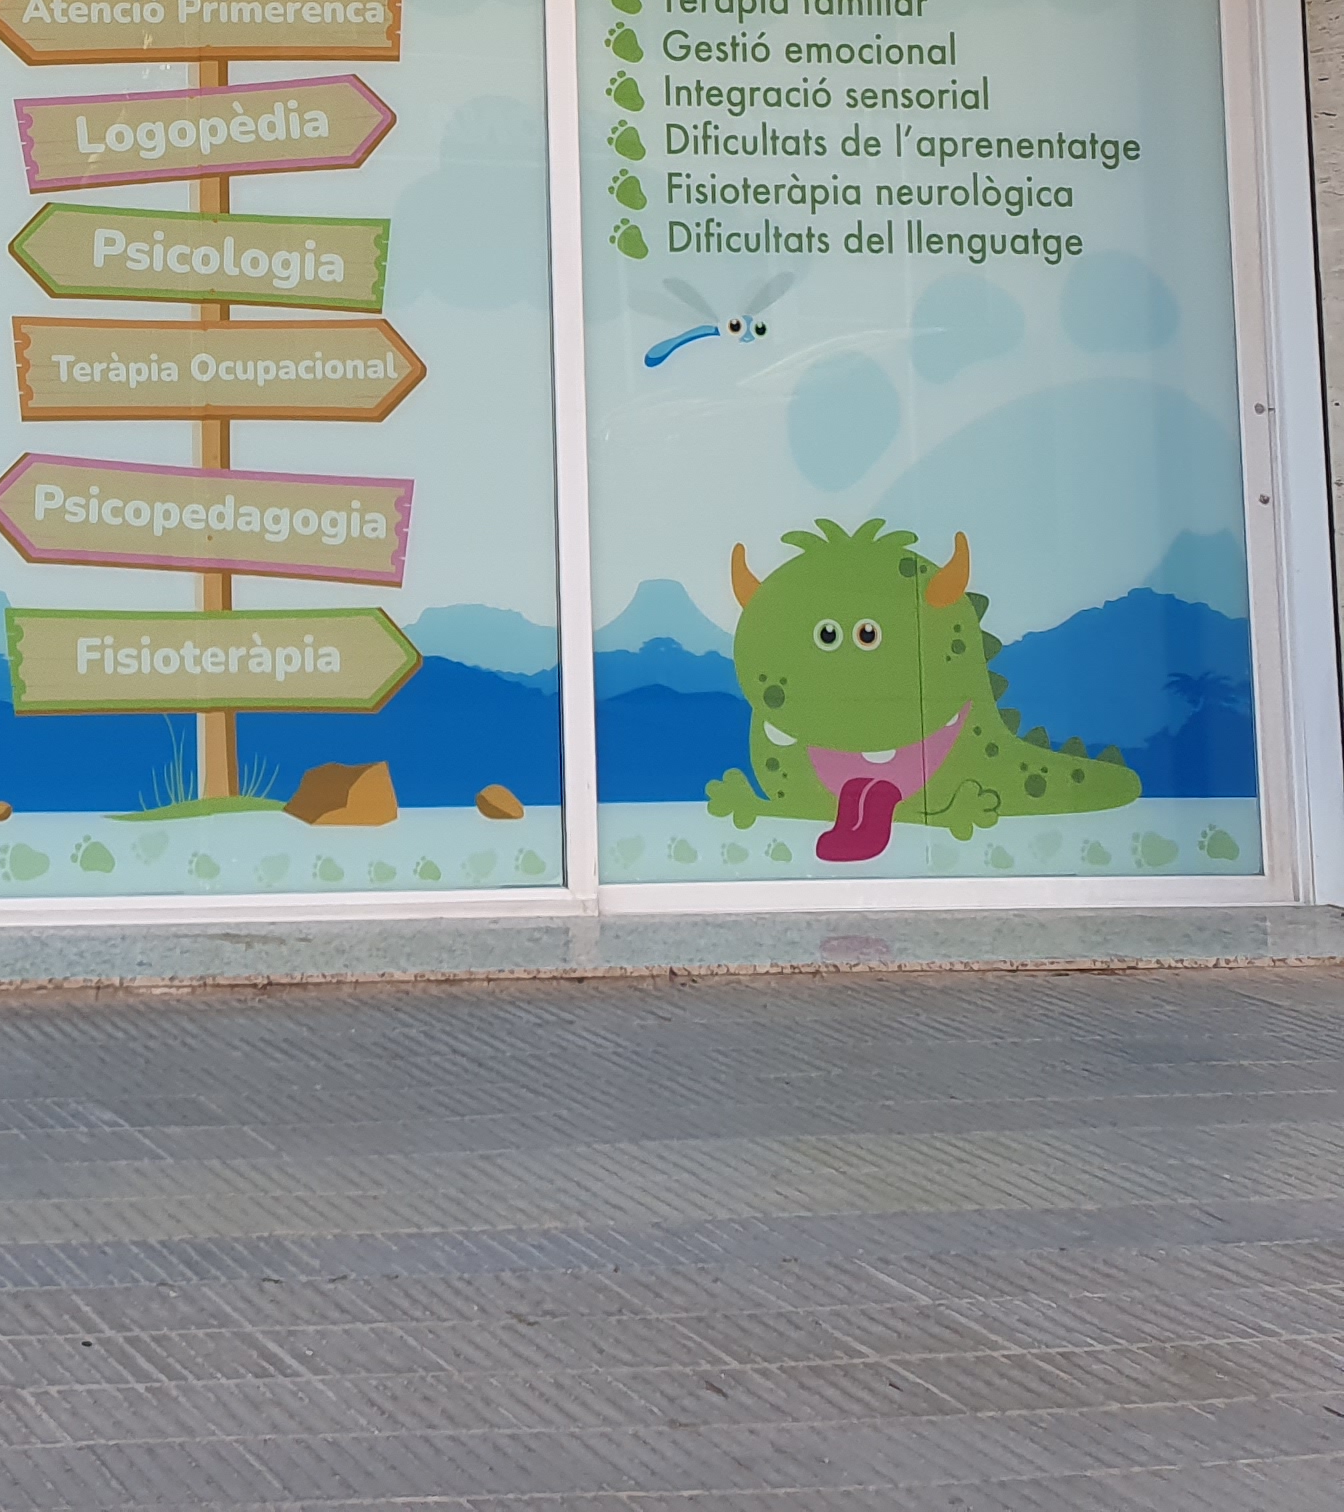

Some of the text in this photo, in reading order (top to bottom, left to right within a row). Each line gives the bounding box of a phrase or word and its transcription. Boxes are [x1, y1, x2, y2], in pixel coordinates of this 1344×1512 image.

[662, 31, 957, 66] Gestió emocional
[664, 74, 990, 116] Integració sensorial
[75, 100, 329, 159] Logopèdia
[665, 122, 827, 158] Dificultats
[840, 123, 882, 158] de
[667, 171, 1074, 216] Fisioteràpia neurològica
[93, 228, 345, 288] Psicologia
[668, 220, 1084, 265] Dificultats del llenguatge
[51, 351, 399, 388] Teràpia Ocupacional
[33, 483, 388, 545] Psicopedagogia
[76, 632, 341, 682] Fisioteràpia
